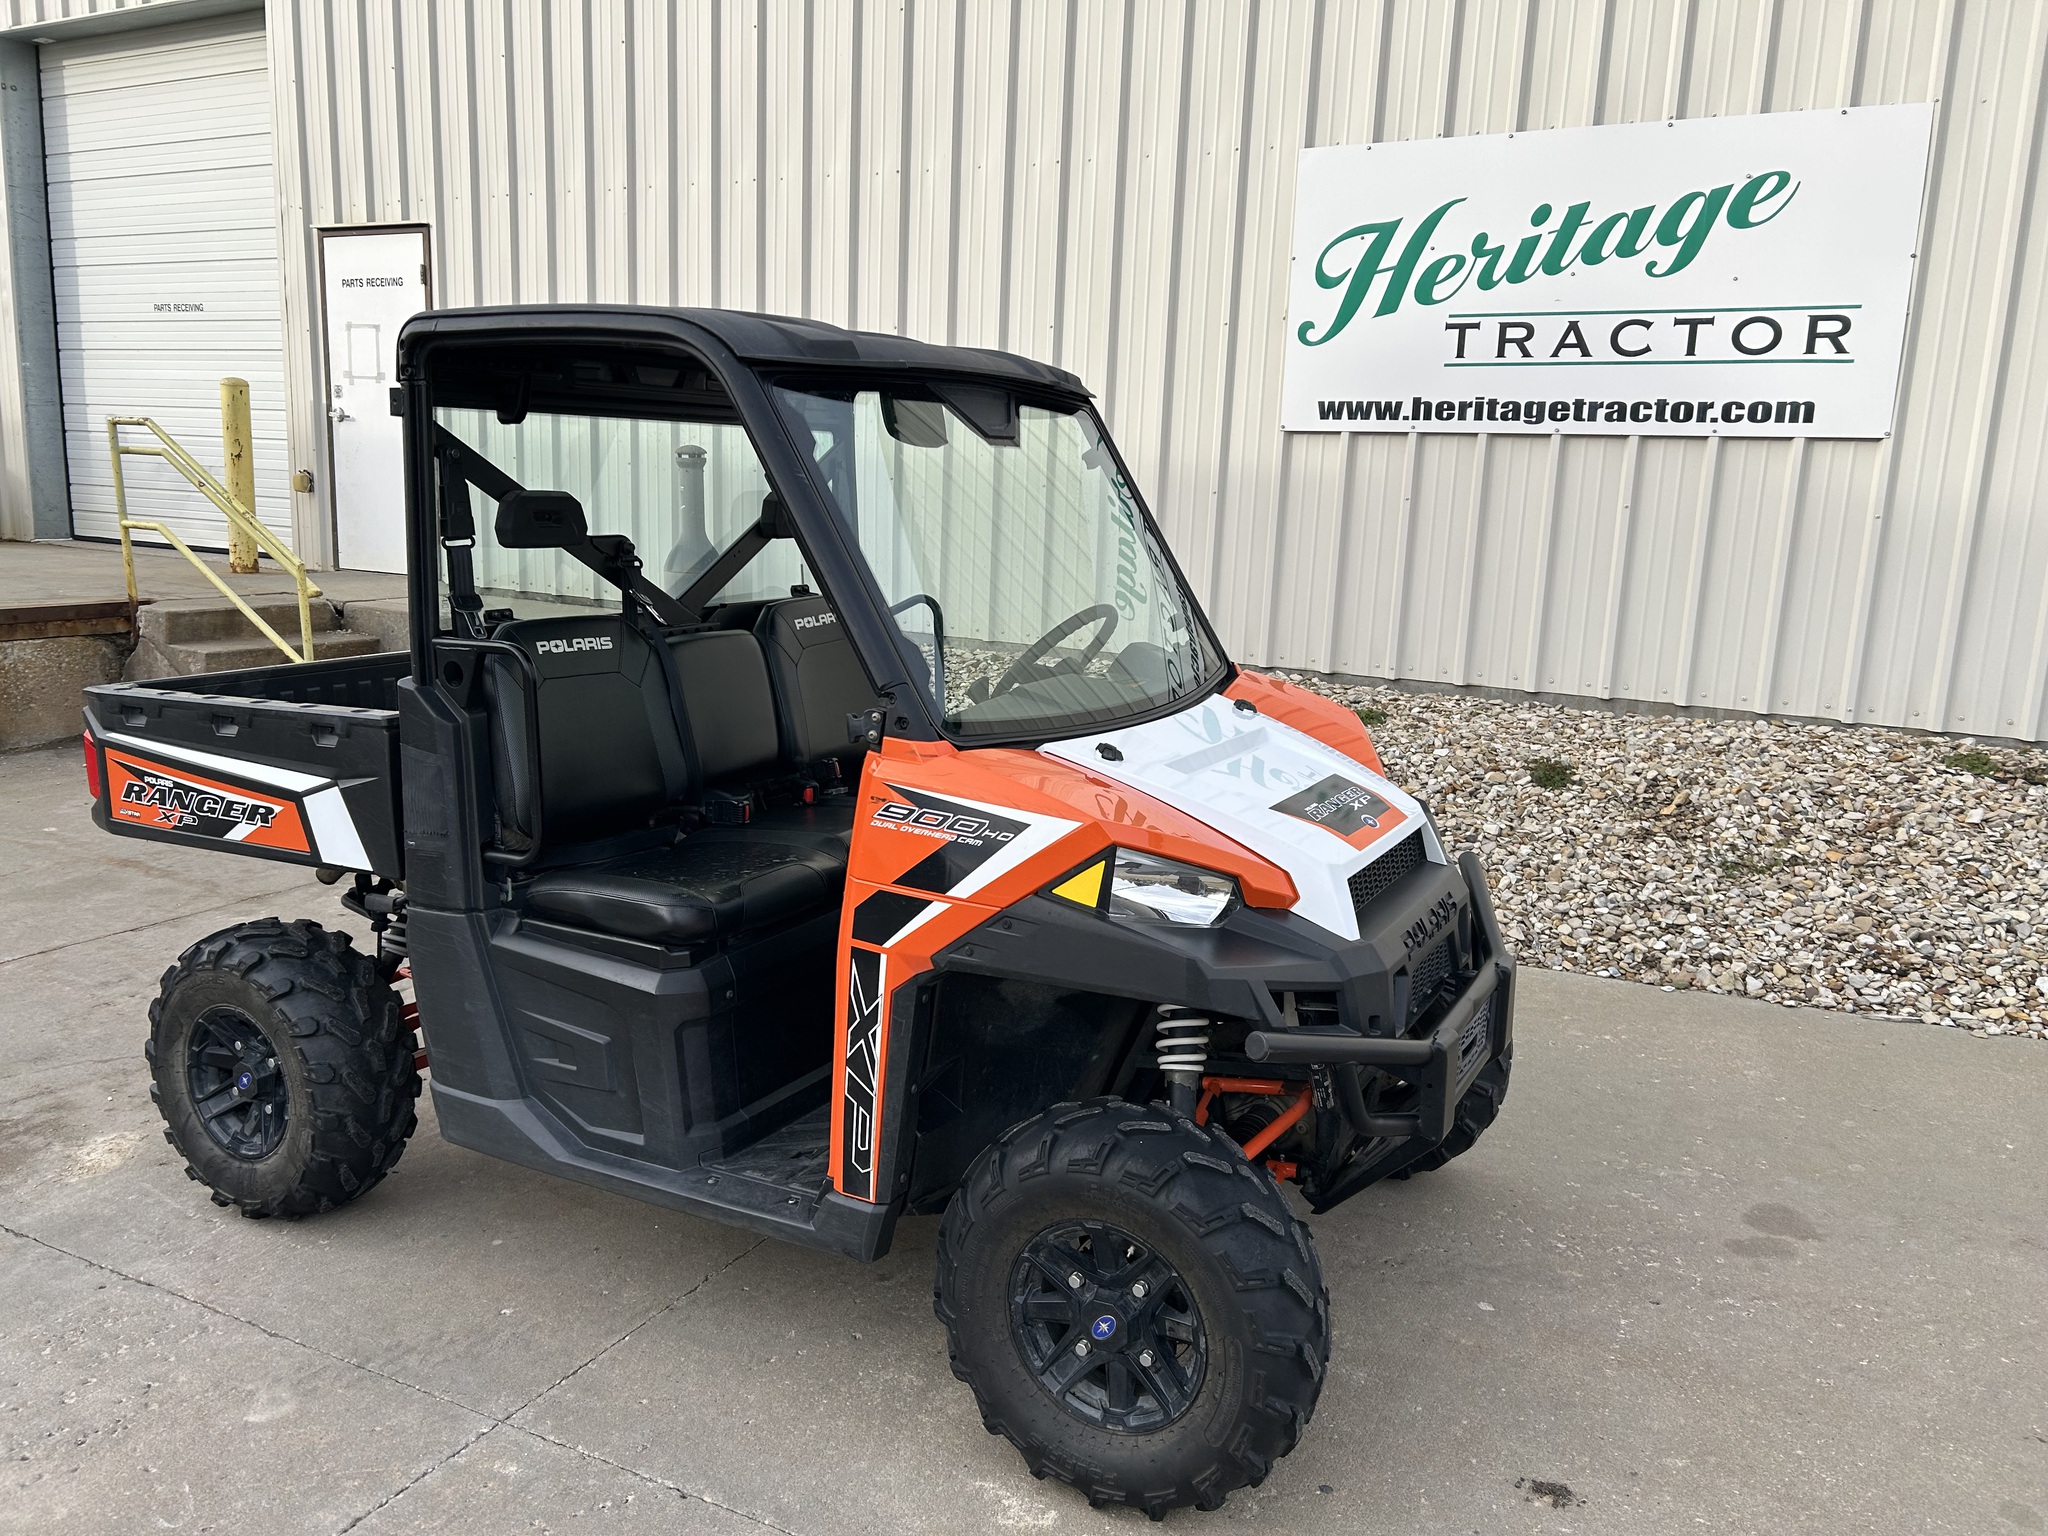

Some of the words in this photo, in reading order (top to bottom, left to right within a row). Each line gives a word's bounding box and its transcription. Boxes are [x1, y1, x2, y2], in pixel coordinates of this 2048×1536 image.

[1297, 171, 1801, 347] Heritage
[341, 278, 364, 288] PARTS
[366, 276, 404, 288] RECEIVING
[153, 303, 172, 312] PARTS
[173, 303, 204, 312] RECEIVING
[1445, 314, 1854, 359] TRACTOR
[1317, 396, 1816, 425] www.heritagetractor.com
[794, 612, 836, 630] POLAR
[535, 636, 613, 655] POLARIS
[144, 775, 174, 788] POLARIS
[121, 780, 277, 828] RANGER
[1307, 786, 1366, 822] RANGER
[1349, 794, 1372, 811] XP
[154, 809, 199, 826] XP
[872, 801, 990, 838] 900
[870, 819, 898, 831] DUAL
[900, 825, 958, 842] OVERHEAD
[957, 836, 984, 847] CAM
[1401, 890, 1458, 962] POLARIS
[845, 957, 884, 1174] XP
